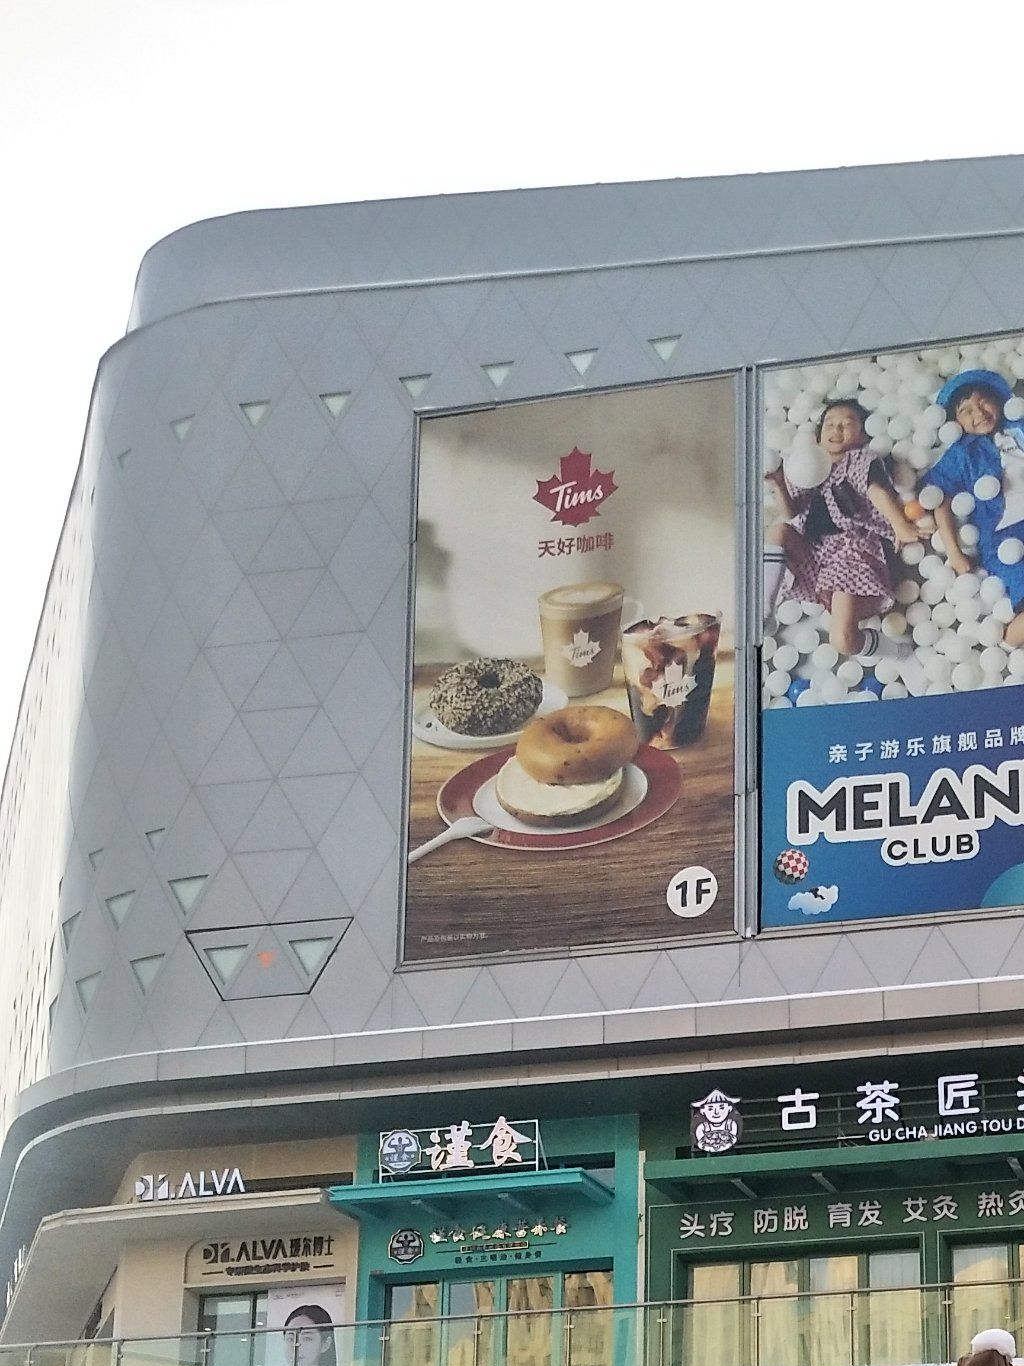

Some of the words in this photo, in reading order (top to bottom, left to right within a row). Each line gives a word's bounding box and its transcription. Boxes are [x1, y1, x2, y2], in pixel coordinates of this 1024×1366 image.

[550, 481, 604, 512] Tims
[538, 532, 614, 558] 天好咖啡
[661, 682, 691, 698] Tims
[887, 833, 974, 861] CLUB
[675, 877, 712, 908] 1F
[425, 1116, 532, 1170] 谨食
[868, 1128, 893, 1142] GU
[895, 1126, 928, 1141] CHA
[931, 1121, 979, 1138] JIANG
[981, 1118, 1014, 1133] TOU
[679, 1210, 735, 1239] 头疗
[753, 1205, 808, 1234] 防脱
[827, 1200, 883, 1229] 育发
[902, 1195, 959, 1223] 艾灸
